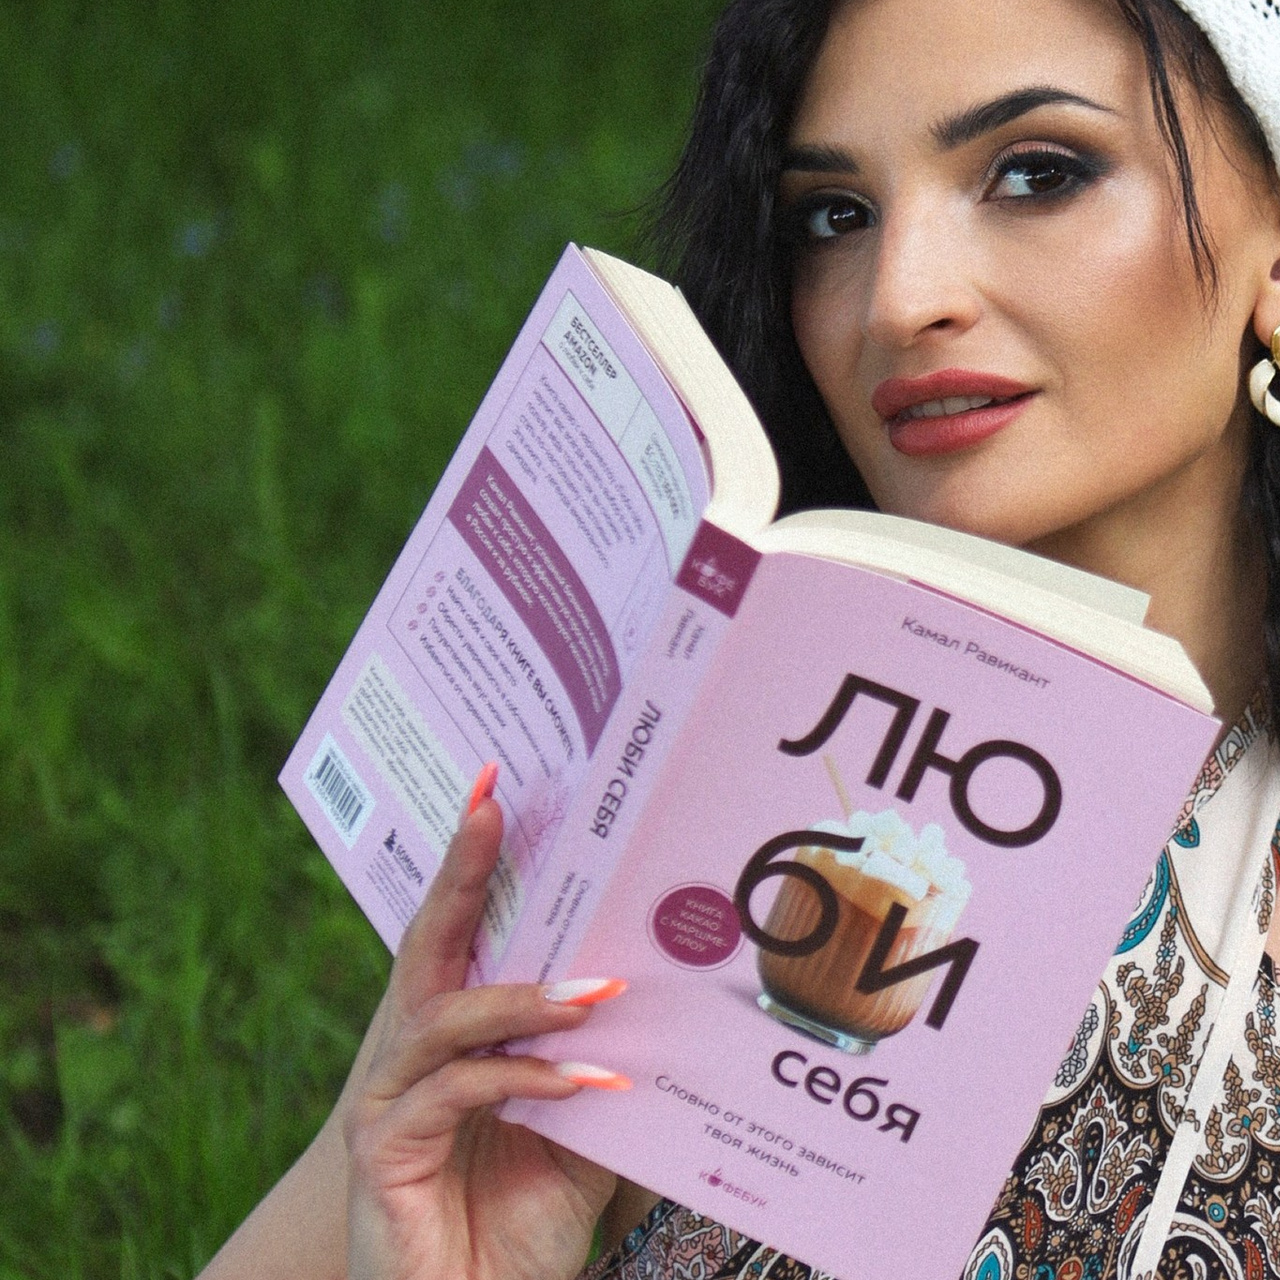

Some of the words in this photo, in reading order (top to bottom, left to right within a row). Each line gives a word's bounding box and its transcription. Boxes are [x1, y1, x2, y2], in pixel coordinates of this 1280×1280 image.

[563, 331, 596, 374] AMAZON
[570, 316, 617, 378] БЕСТСЕЛЛЕР
[486, 474, 506, 503] Камал
[470, 517, 494, 550] России
[501, 517, 528, 555] простую
[437, 601, 464, 639] Обрести
[446, 585, 466, 613] Найти
[465, 613, 480, 634] себя
[455, 567, 508, 640] БЛАГОДАРЯ
[506, 639, 534, 679] КНИГЕ
[532, 677, 547, 700] ВЫ
[419, 635, 455, 684] Избавиться
[901, 617, 960, 651] Камал
[964, 641, 1051, 689] Равикант
[616, 699, 662, 778] ЛЮБИ
[776, 672, 1062, 849] ЛЮ
[589, 778, 627, 839] СЕБЯ
[396, 845, 423, 884] БОМБОРА
[681, 910, 719, 932] КАКАО
[686, 899, 723, 920] КНИГА
[673, 934, 708, 952] ЛЛОУ
[770, 1049, 922, 1144] себя
[655, 1075, 720, 1116] Словно
[722, 1110, 744, 1127] от
[746, 1122, 795, 1152] этого
[796, 1146, 866, 1186] зависит
[703, 1123, 744, 1150] твоя
[746, 1147, 800, 1178] жизнь
